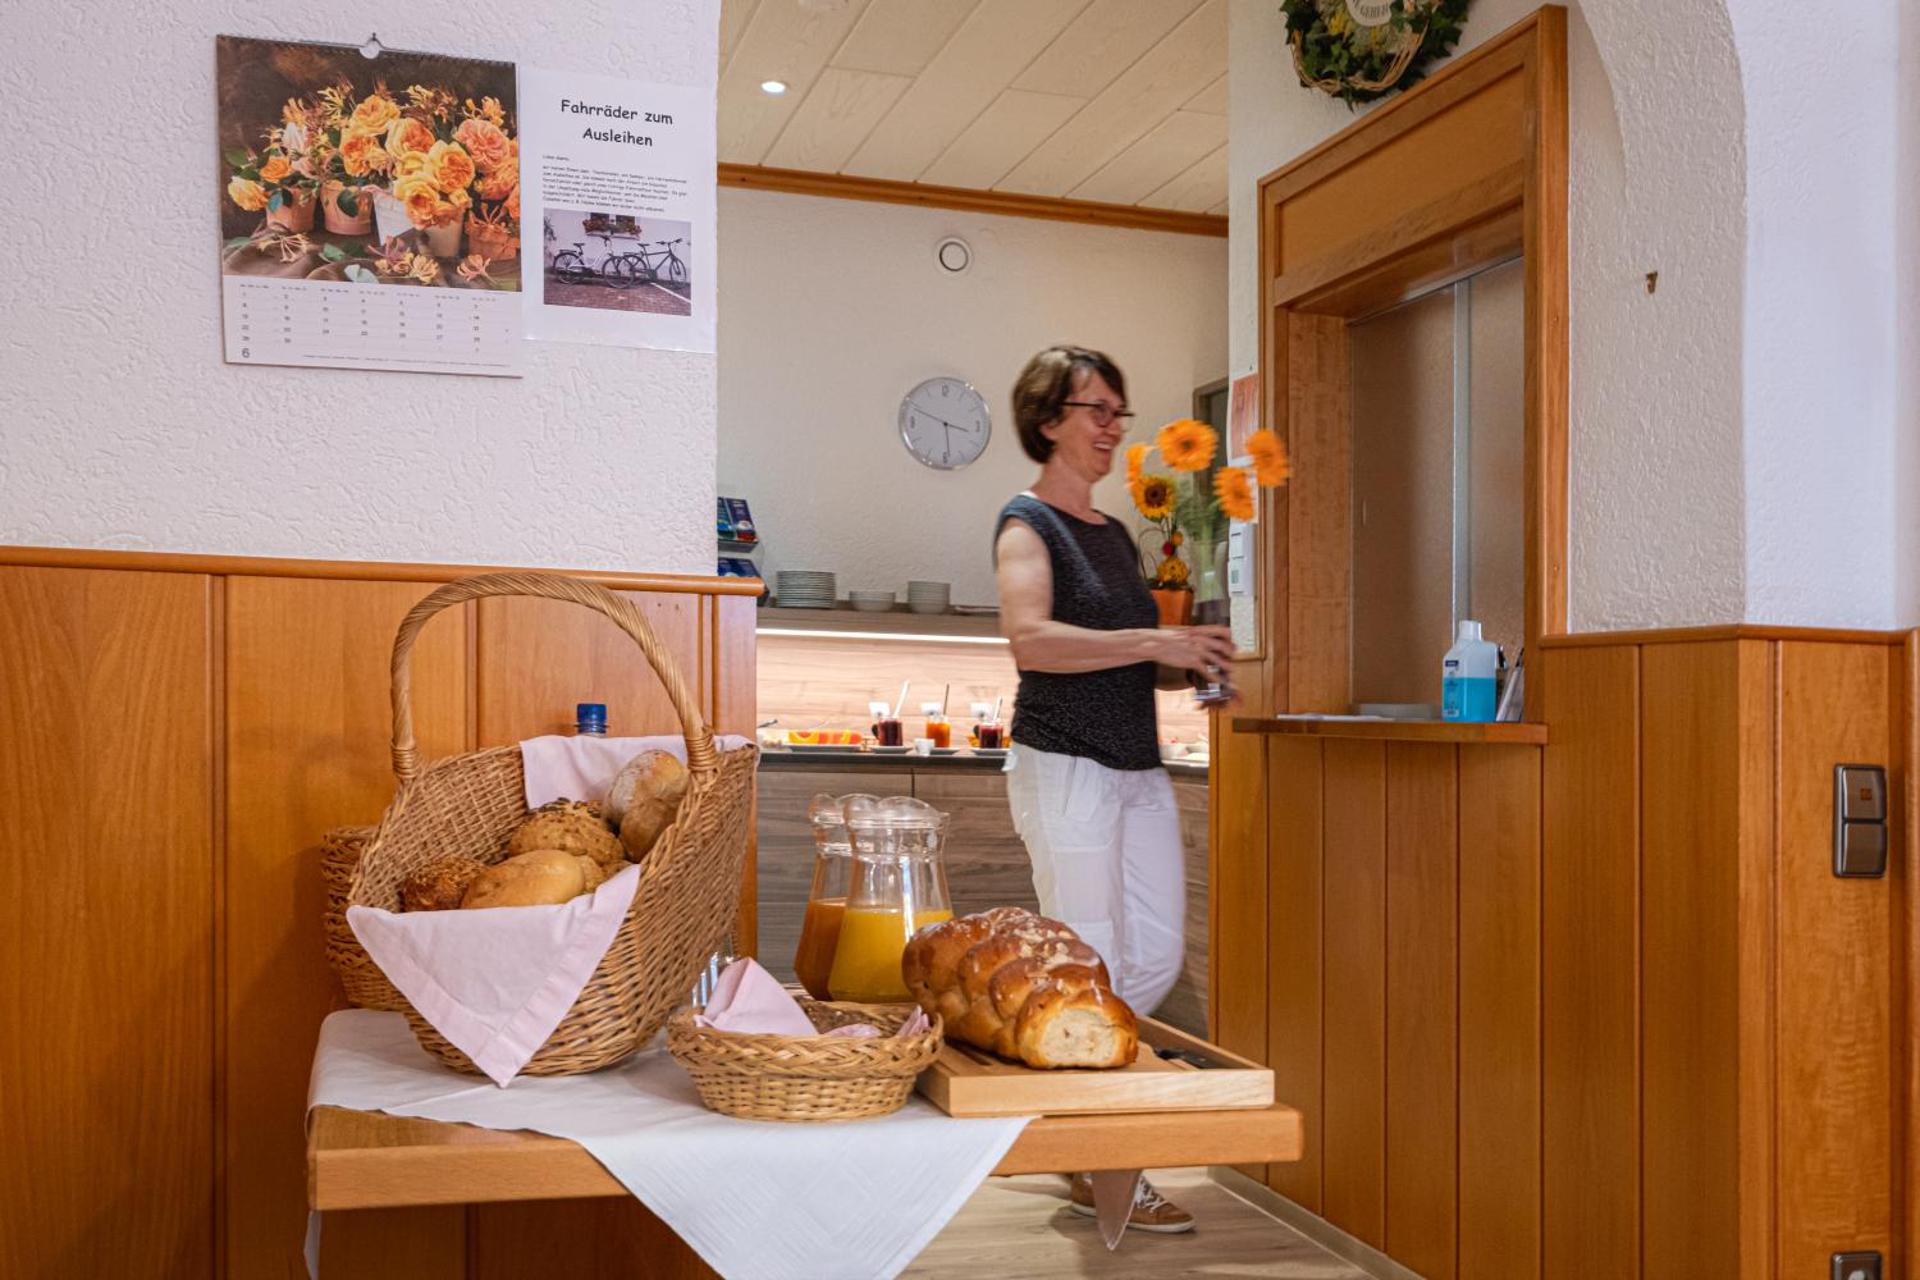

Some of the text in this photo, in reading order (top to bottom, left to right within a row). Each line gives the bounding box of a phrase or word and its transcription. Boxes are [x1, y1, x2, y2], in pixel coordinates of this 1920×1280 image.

[561, 99, 673, 125] Fahrräder zum
[582, 127, 653, 147] Ausleihen
[241, 347, 250, 359] 6
